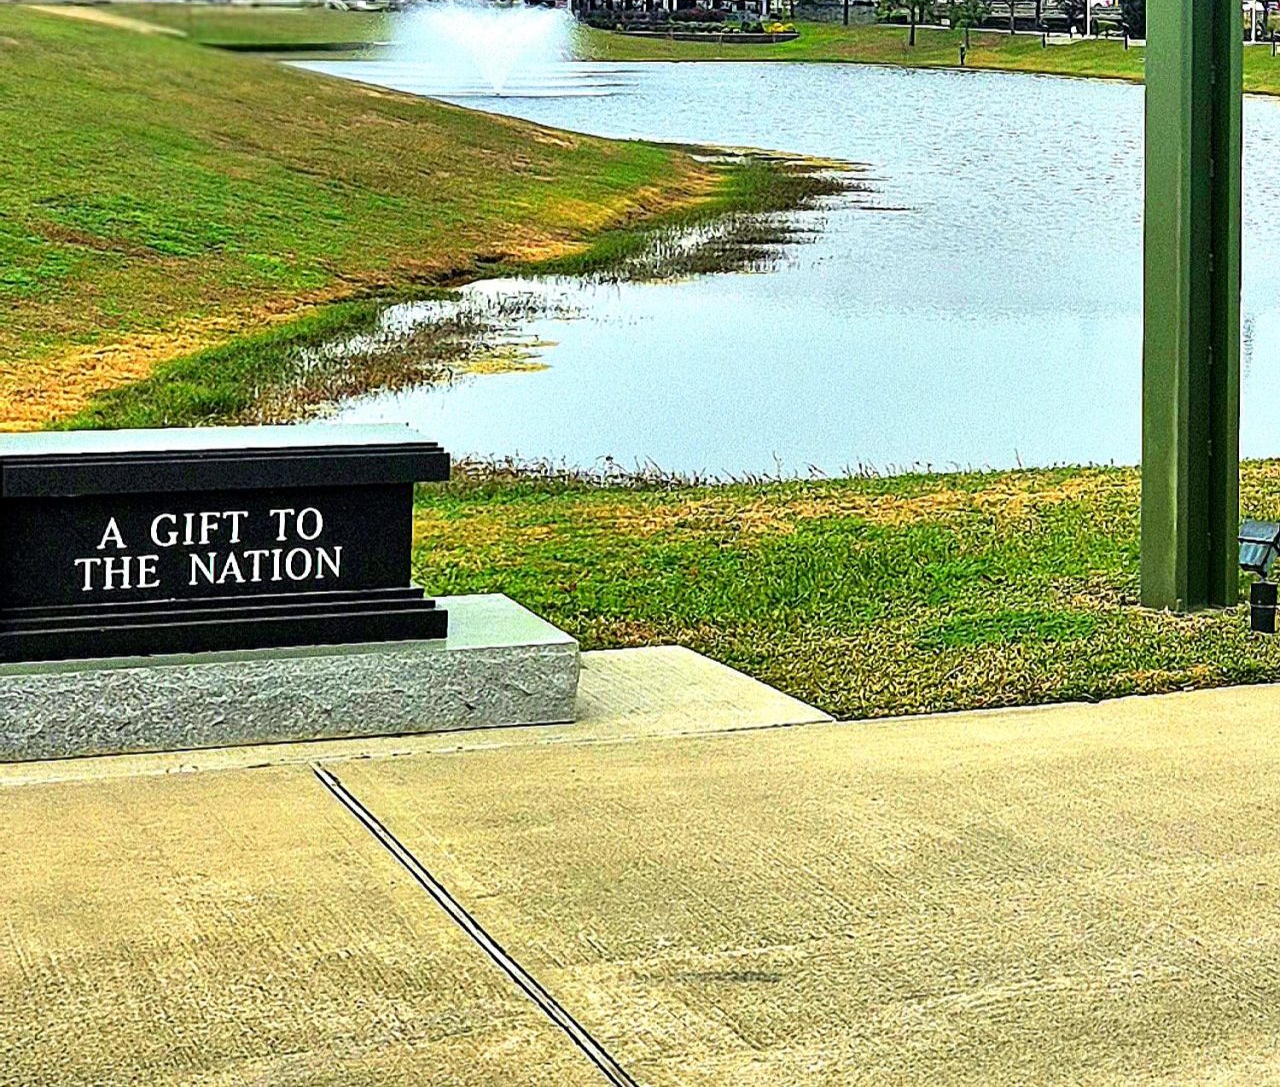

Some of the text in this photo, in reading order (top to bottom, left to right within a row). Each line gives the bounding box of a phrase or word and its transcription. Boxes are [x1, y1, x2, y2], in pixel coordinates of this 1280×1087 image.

[97, 507, 323, 549] A GIFT TO
[75, 546, 342, 591] THE NATION
